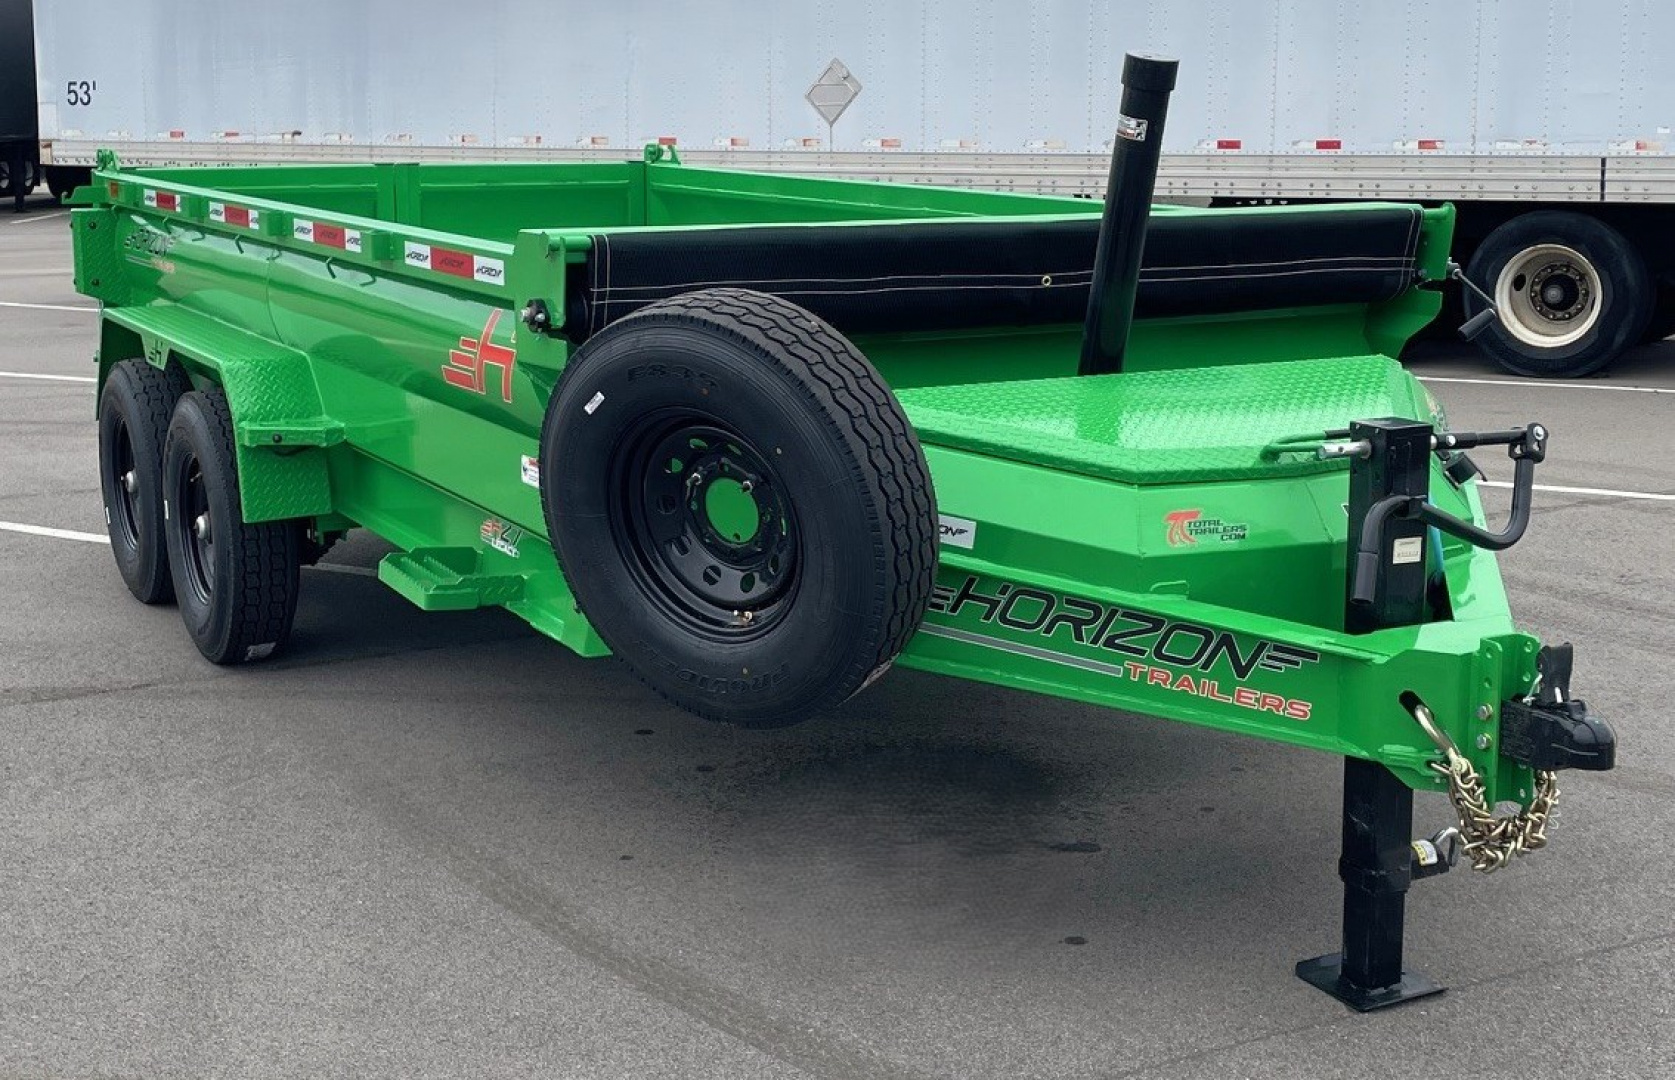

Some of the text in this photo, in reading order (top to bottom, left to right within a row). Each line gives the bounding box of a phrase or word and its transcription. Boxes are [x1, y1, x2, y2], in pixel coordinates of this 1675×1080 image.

[67, 80, 97, 106] 53'
[1187, 519, 1224, 528] TOTAL
[1188, 524, 1247, 536] TRAILERS
[948, 575, 1270, 681] HORIZON
[1123, 661, 1312, 721] TRAILERS
